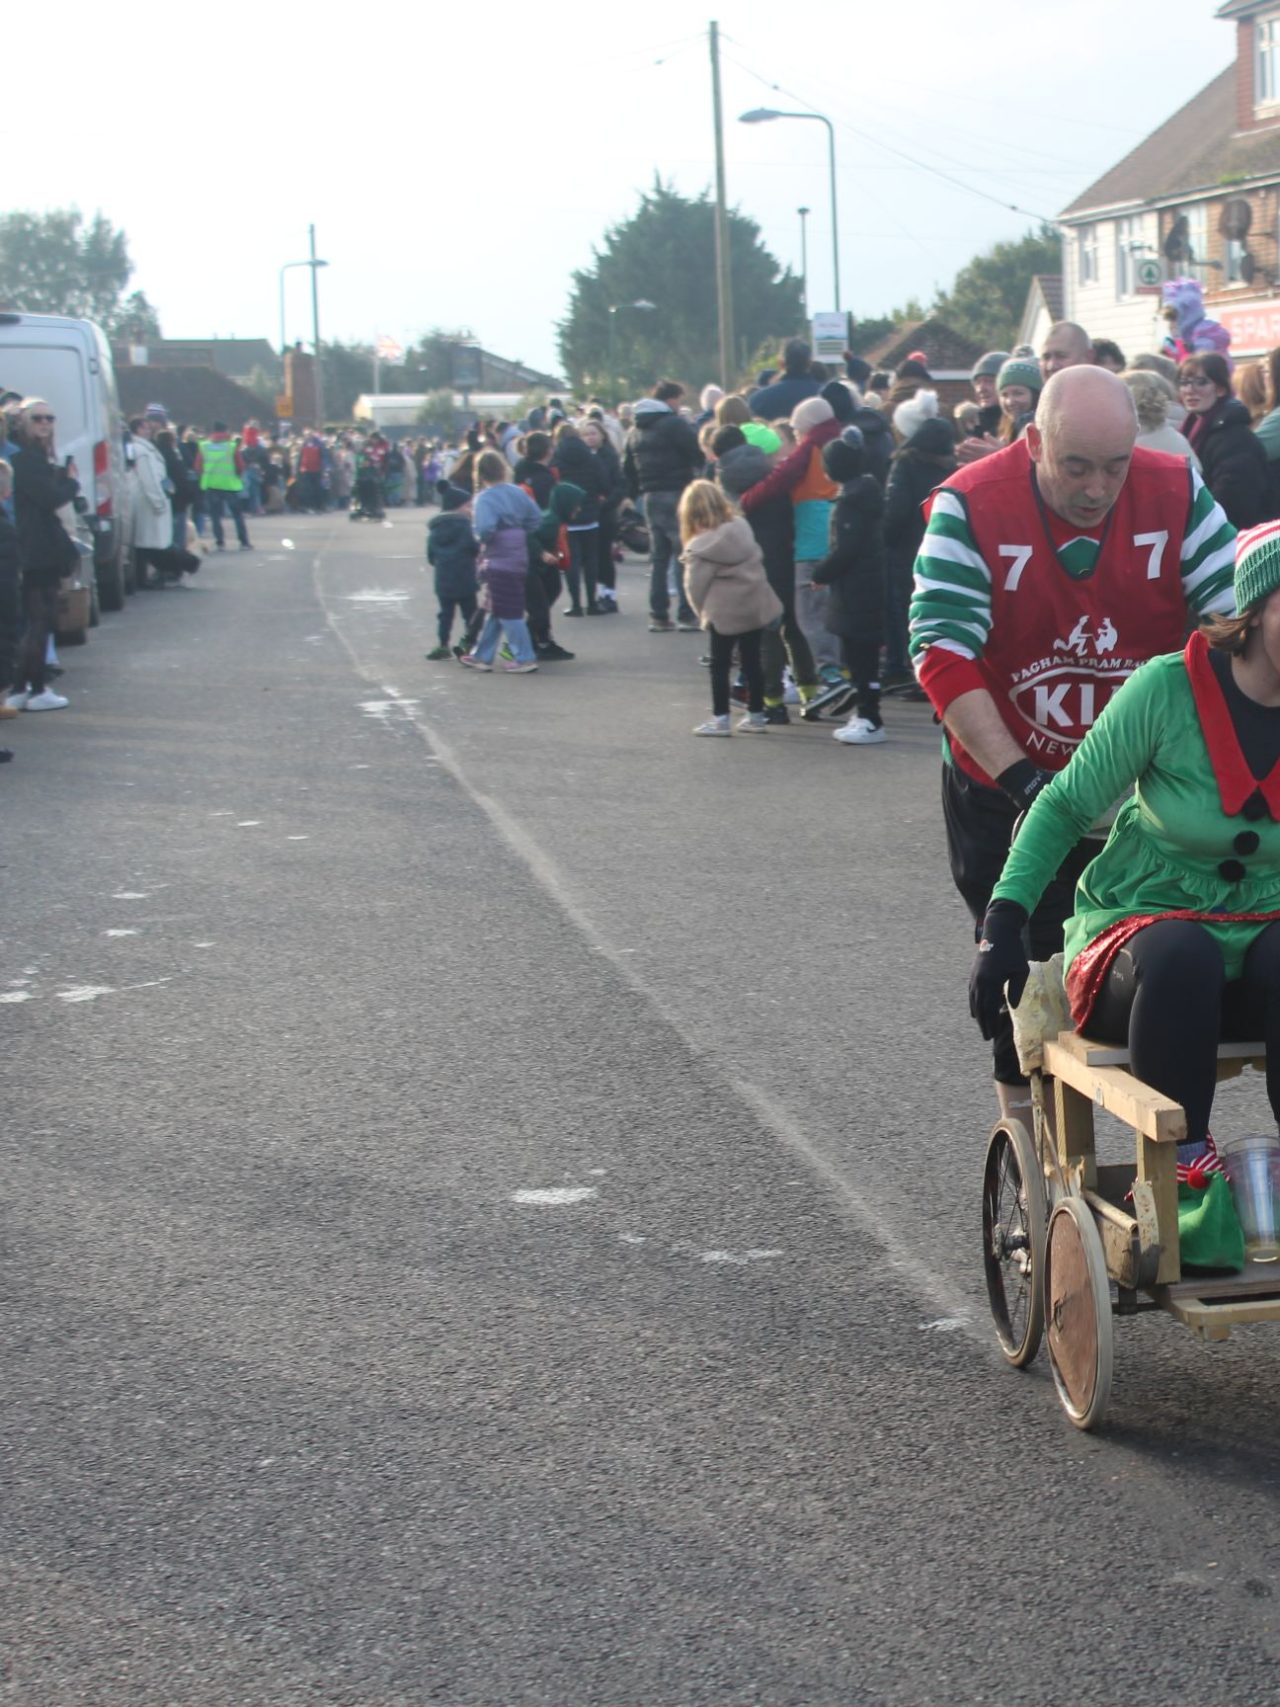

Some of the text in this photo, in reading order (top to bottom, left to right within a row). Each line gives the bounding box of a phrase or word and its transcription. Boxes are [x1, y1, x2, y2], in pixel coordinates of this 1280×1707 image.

[999, 544, 1033, 591] 7
[1133, 530, 1168, 580] 7
[1011, 656, 1075, 682] PAGHAM
[1080, 657, 1122, 669] PRAM
[1033, 683, 1123, 727] KI
